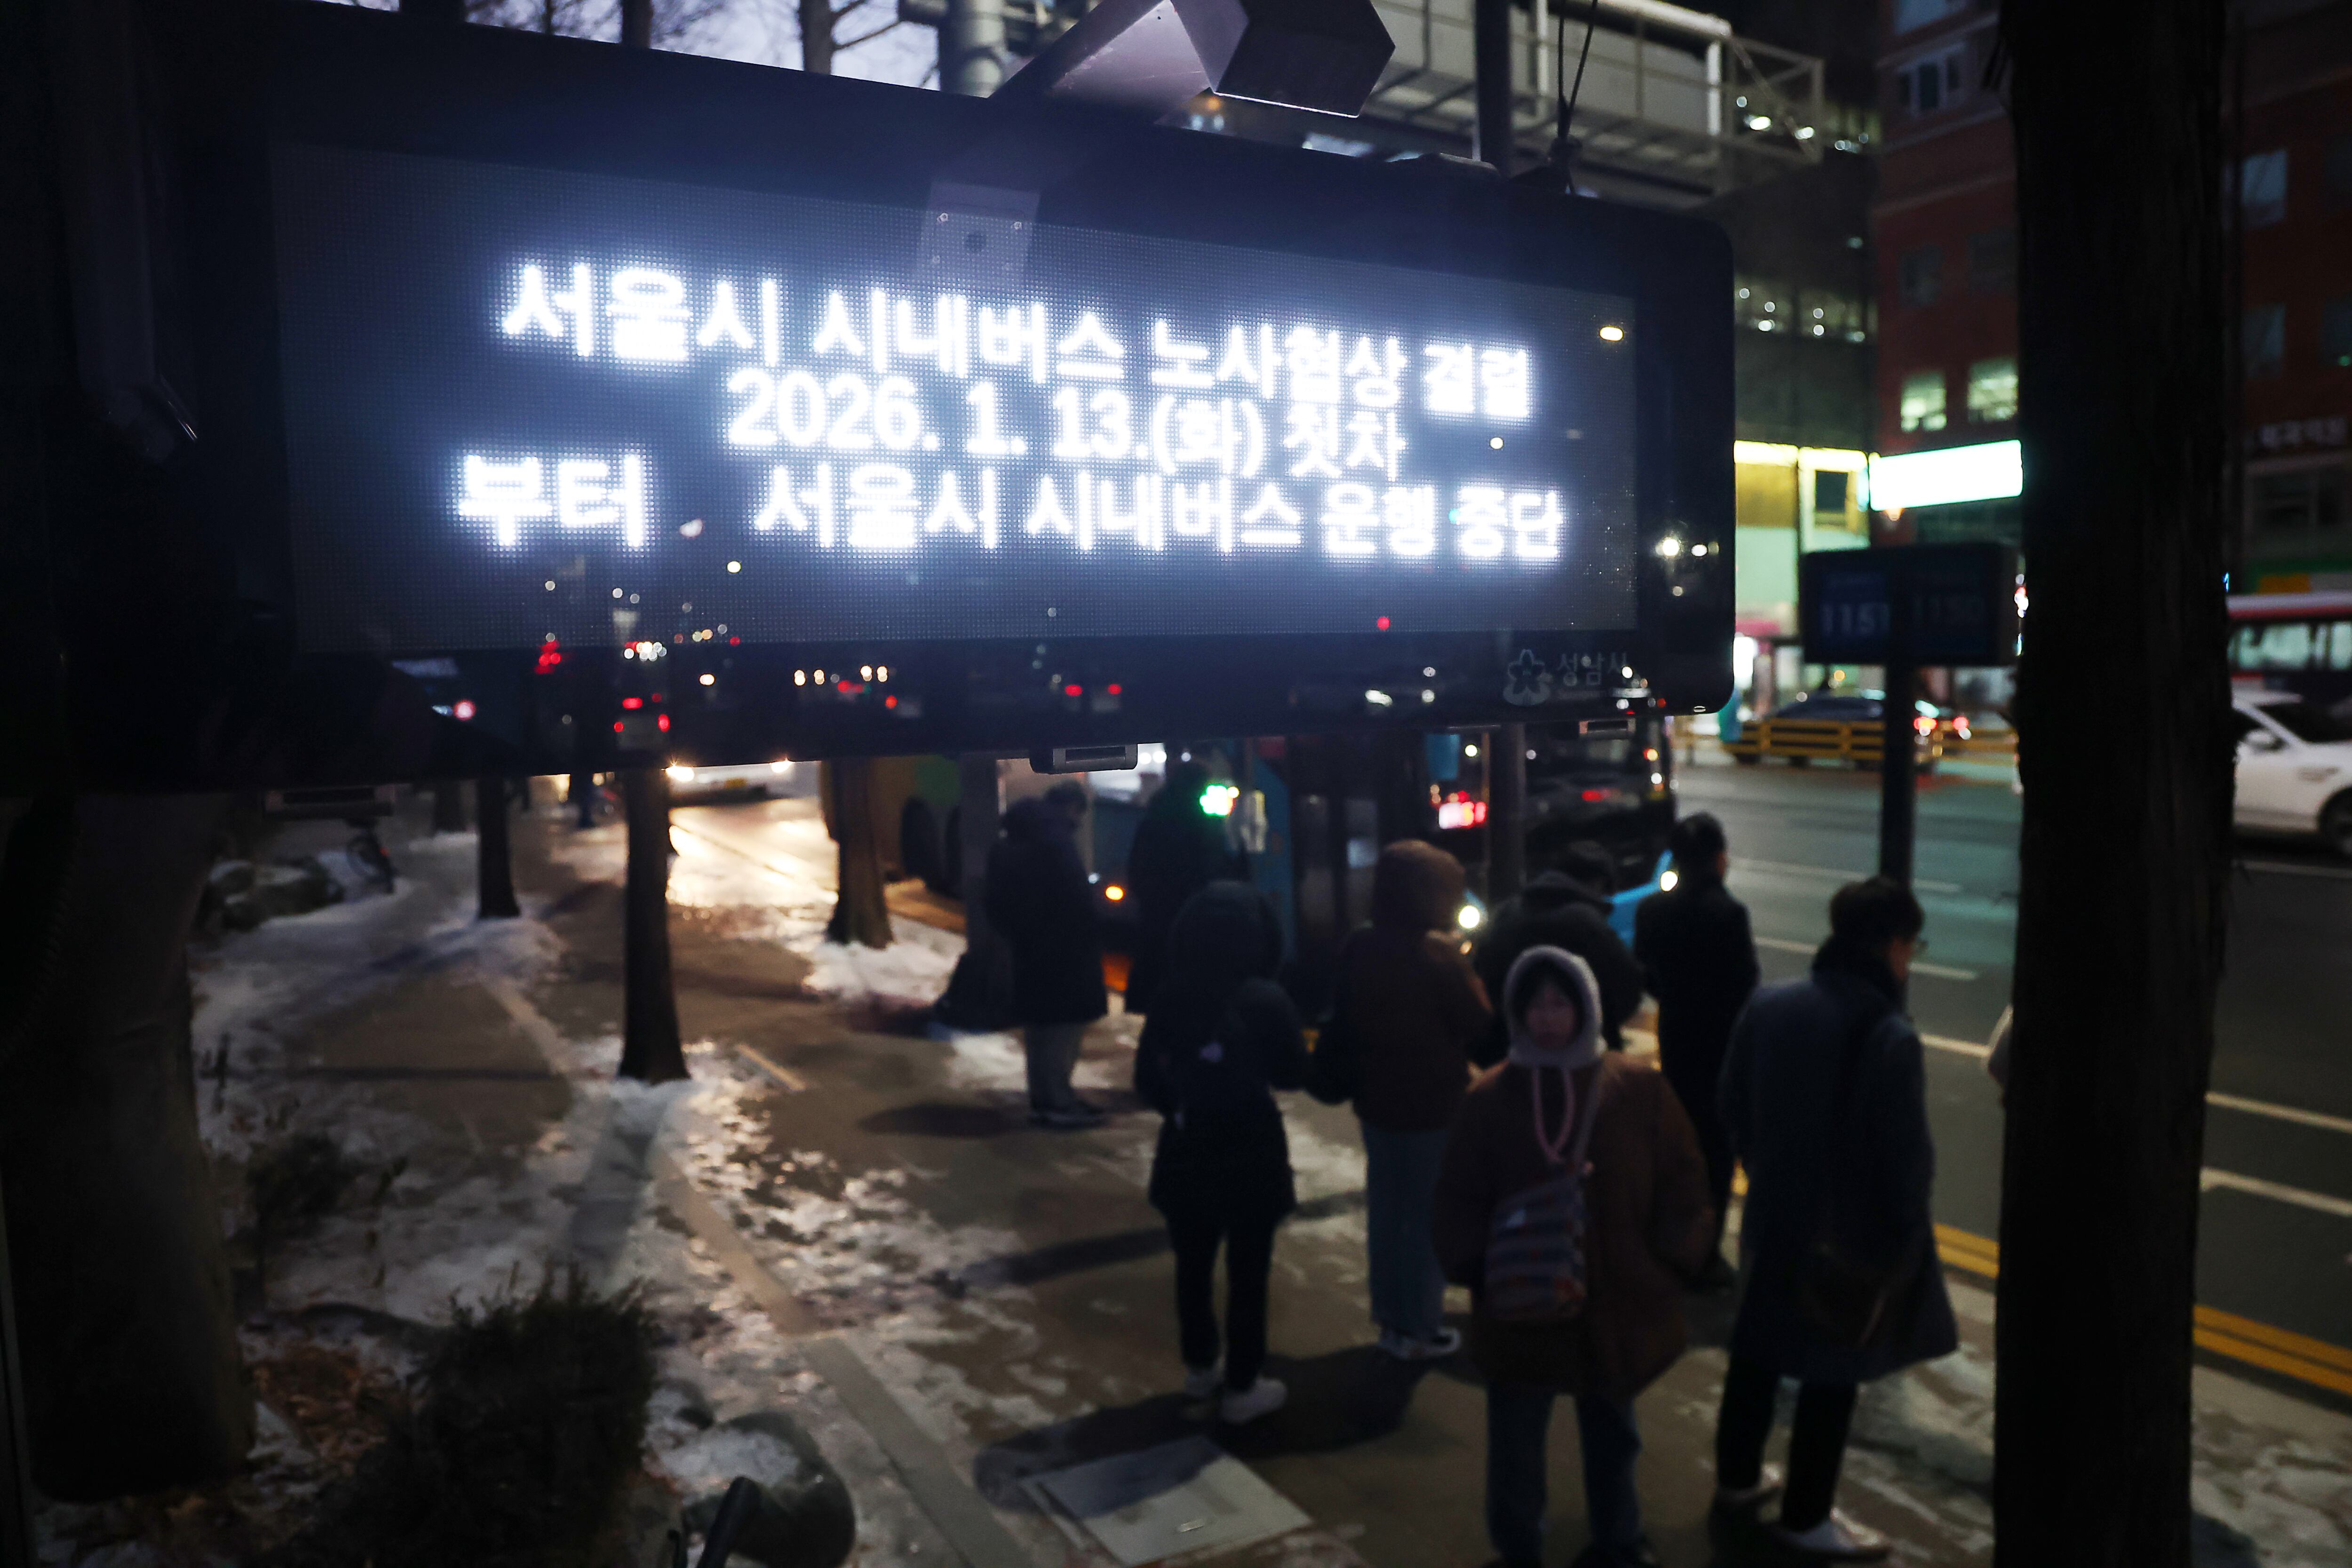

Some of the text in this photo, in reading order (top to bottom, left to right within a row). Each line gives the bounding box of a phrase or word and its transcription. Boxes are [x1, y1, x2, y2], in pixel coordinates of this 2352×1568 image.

[498, 259, 785, 368] 서울시
[811, 284, 1130, 386] 시내버스
[1420, 338, 1534, 420] 결렬
[723, 367, 941, 453] 2026.
[965, 379, 1028, 456] 1.
[1281, 403, 1408, 483] 첫차
[454, 449, 1565, 560] 부터 서울시 시내버스 운행 중단
